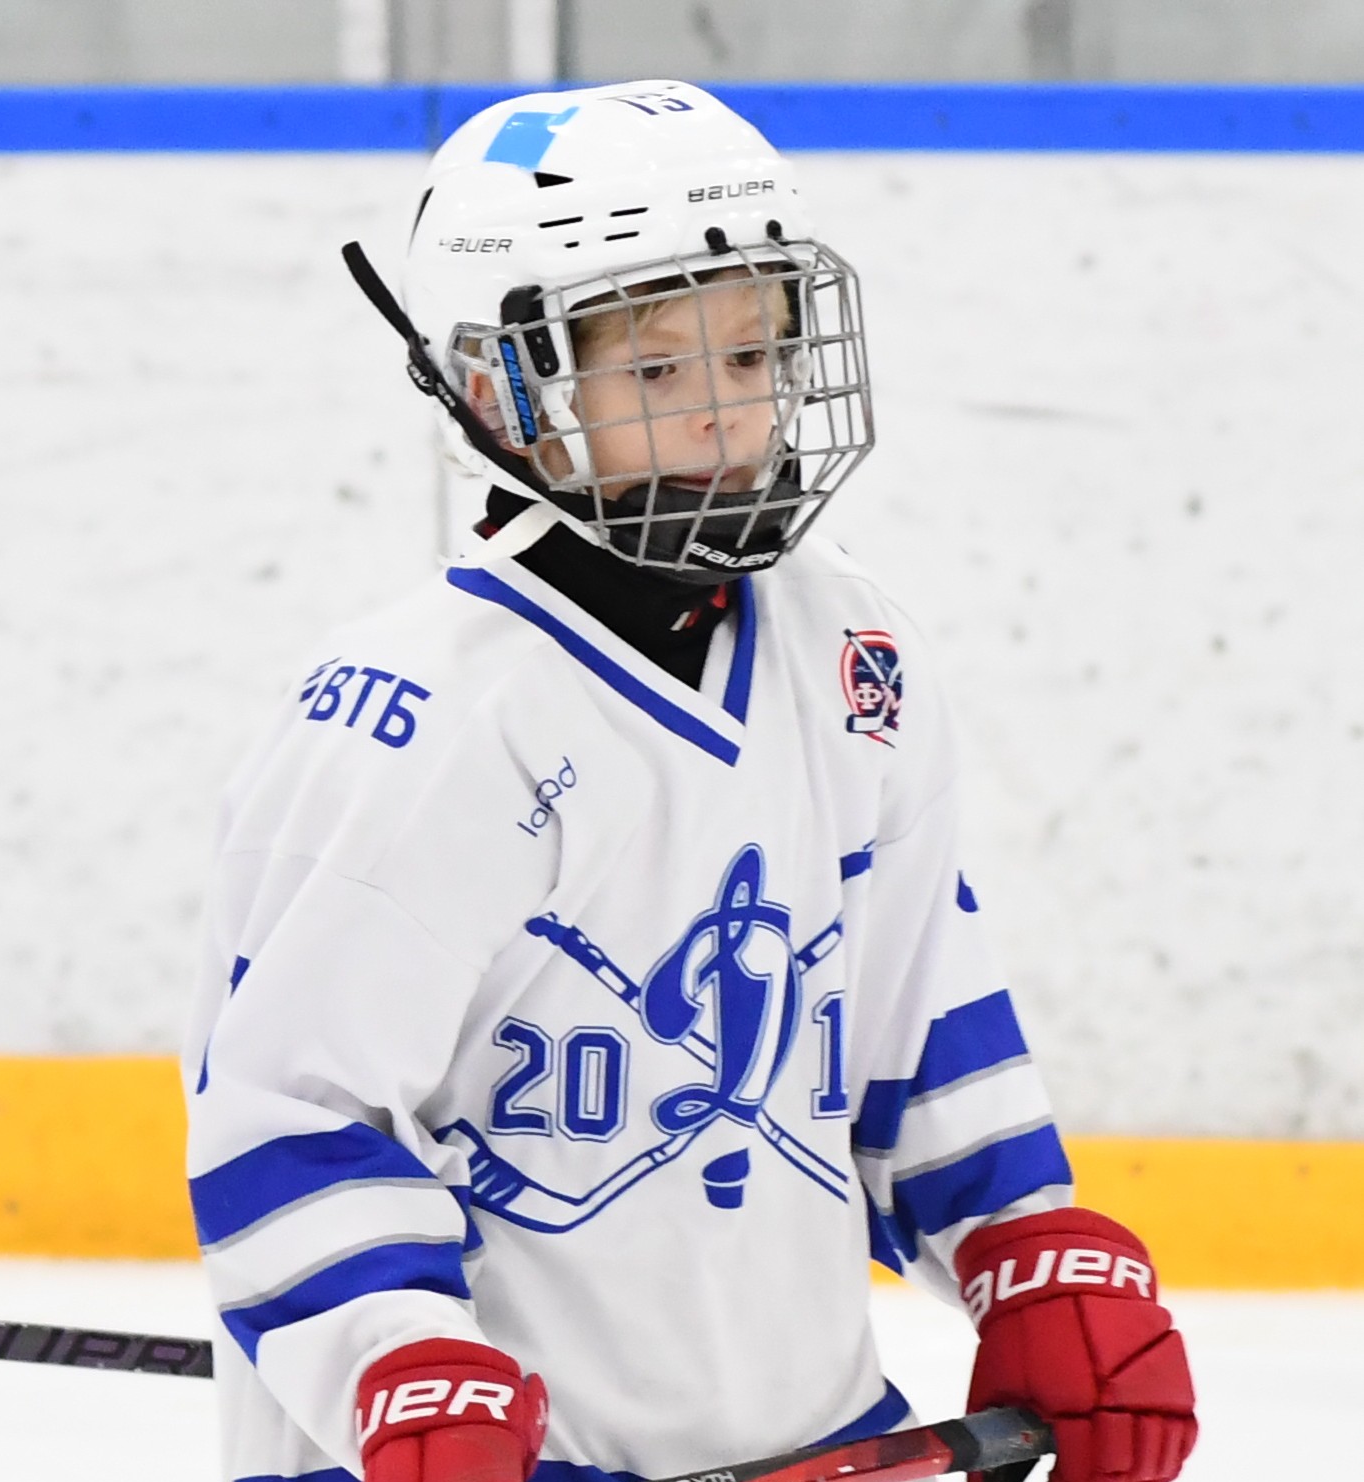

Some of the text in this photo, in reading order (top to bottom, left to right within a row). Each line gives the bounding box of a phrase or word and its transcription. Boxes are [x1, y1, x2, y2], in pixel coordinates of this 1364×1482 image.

[688, 180, 775, 203] BAUER
[487, 1015, 631, 1143] 20
[963, 1248, 1152, 1334] AUER
[356, 1379, 516, 1449] UER
